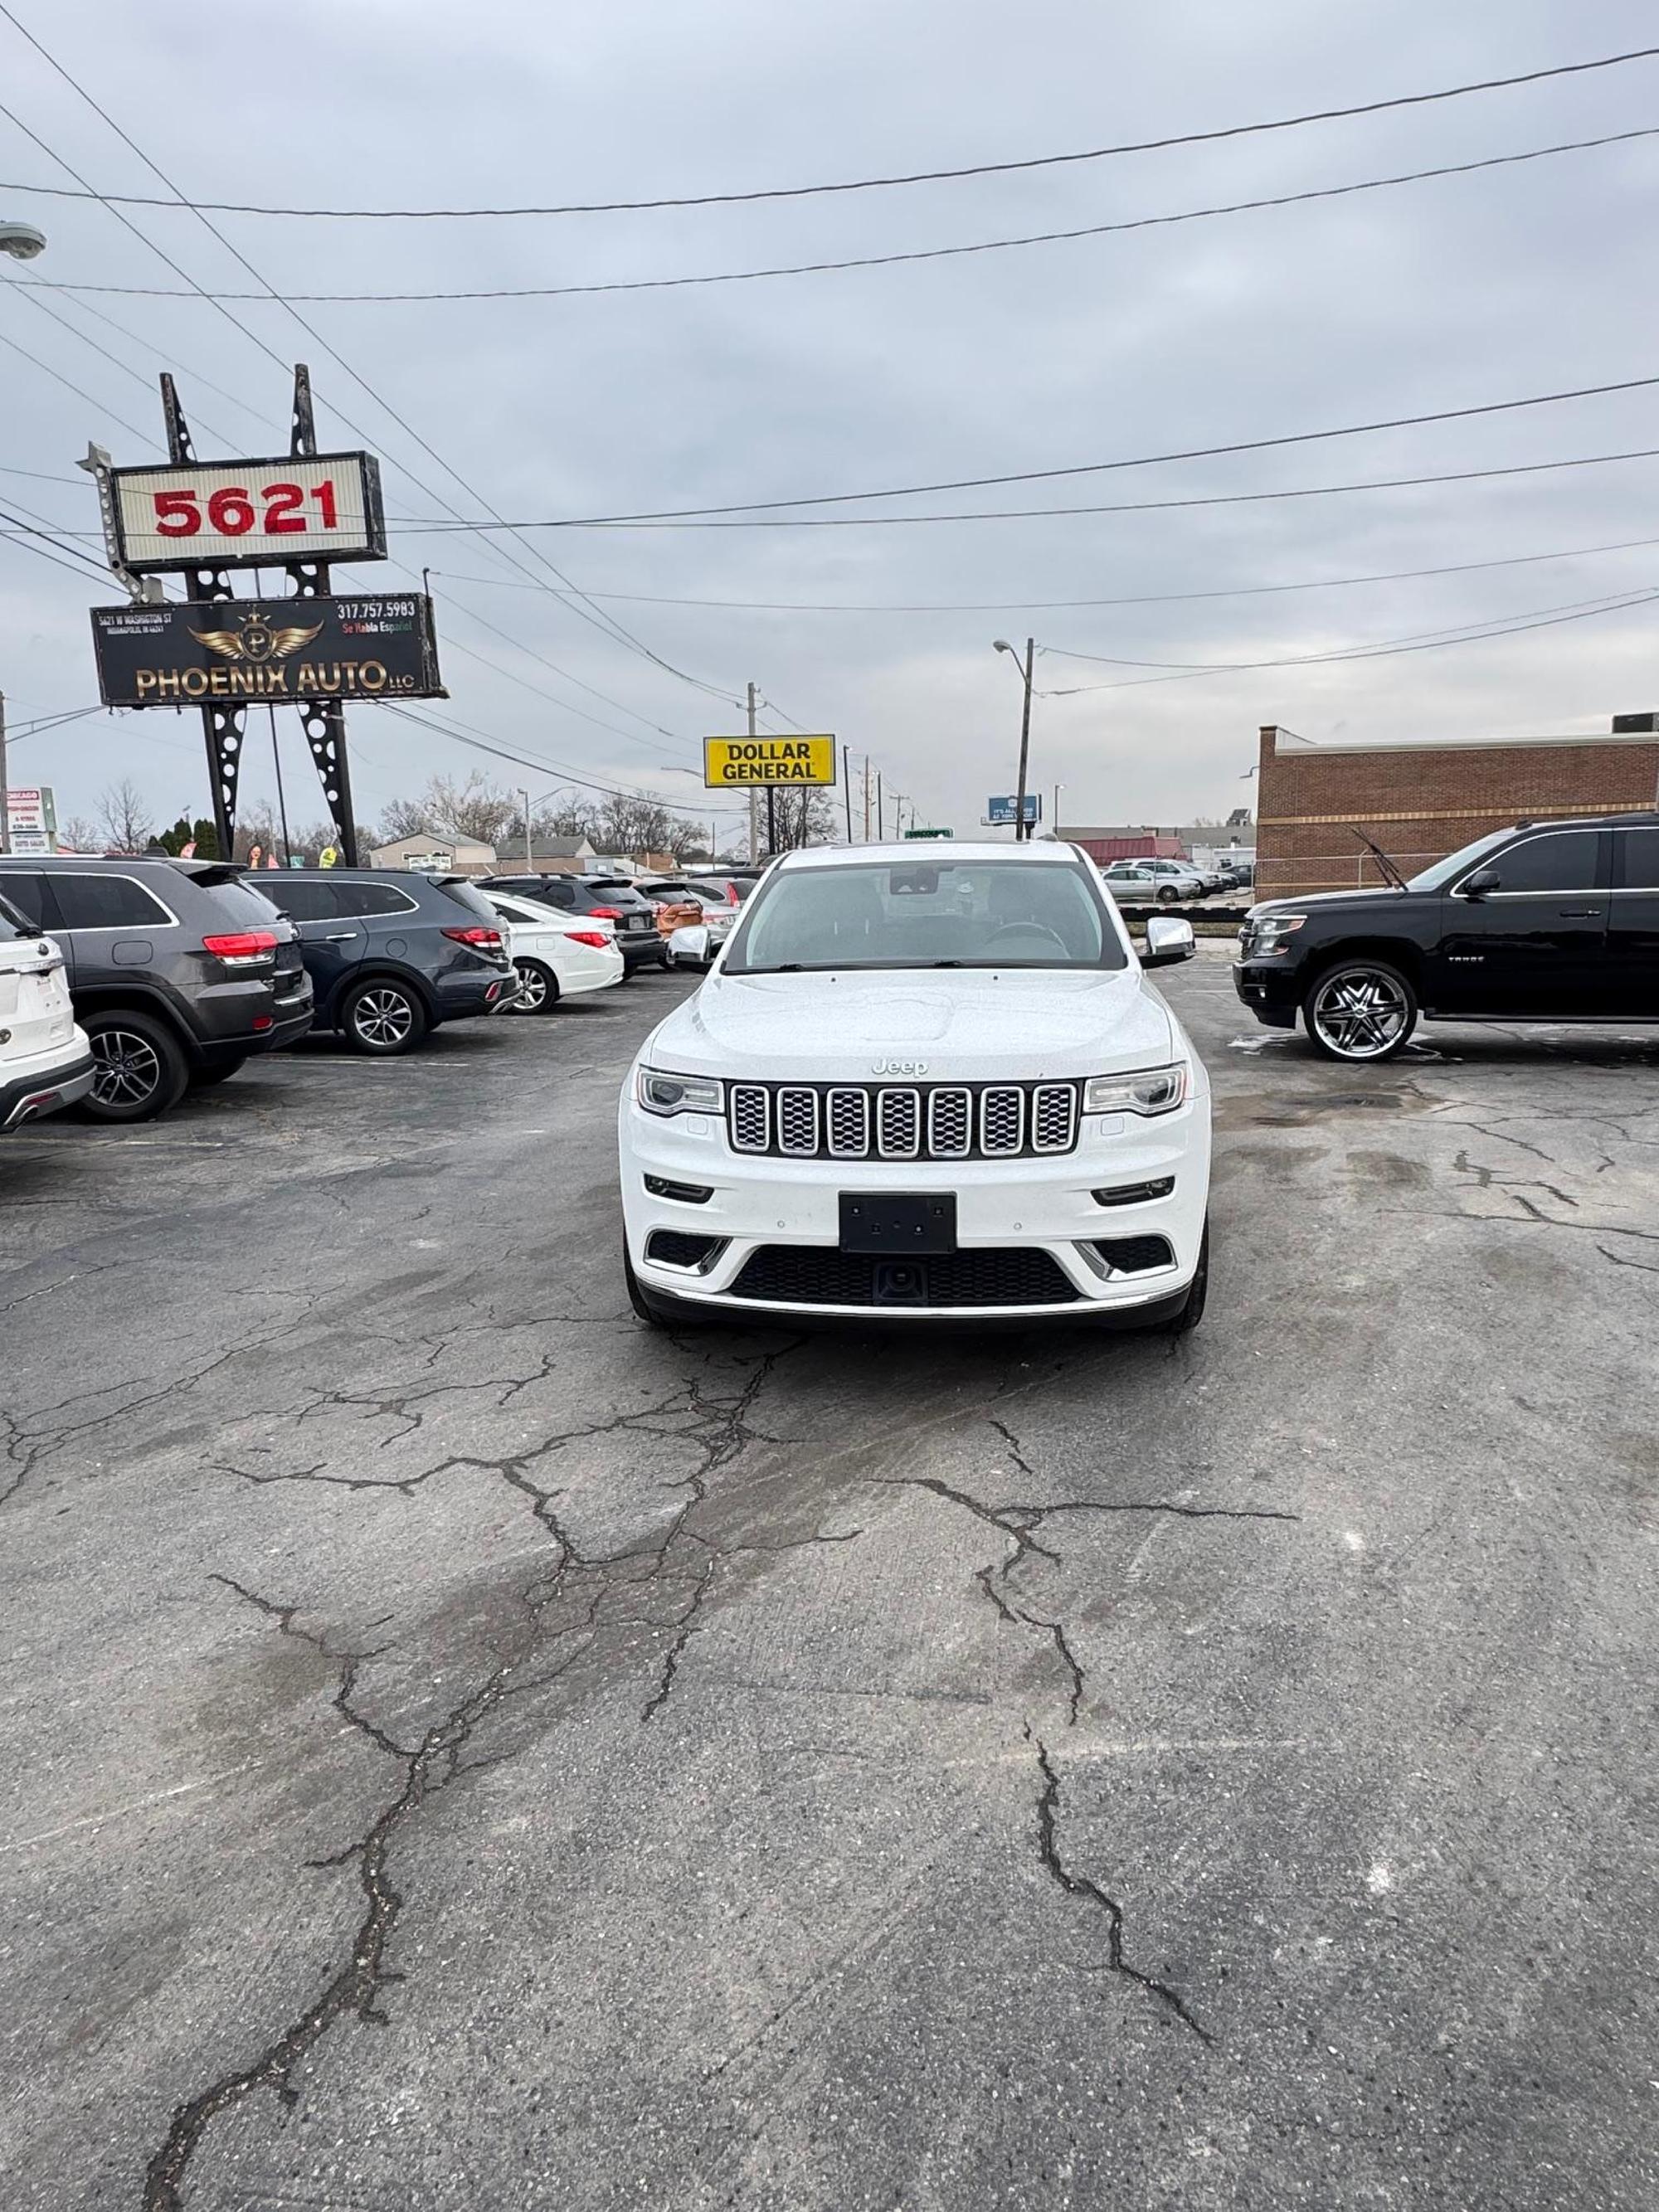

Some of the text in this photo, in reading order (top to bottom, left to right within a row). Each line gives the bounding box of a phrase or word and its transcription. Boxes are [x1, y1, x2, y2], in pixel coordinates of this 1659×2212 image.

[153, 479, 337, 537] 5621
[337, 601, 415, 619] 317.757.5983
[342, 623, 353, 634] Se
[136, 660, 415, 698] PHOENIX AUTO LLC
[727, 743, 810, 761] DOLLAR
[722, 762, 816, 780] GENERAL
[871, 1058, 929, 1078] Jeep
